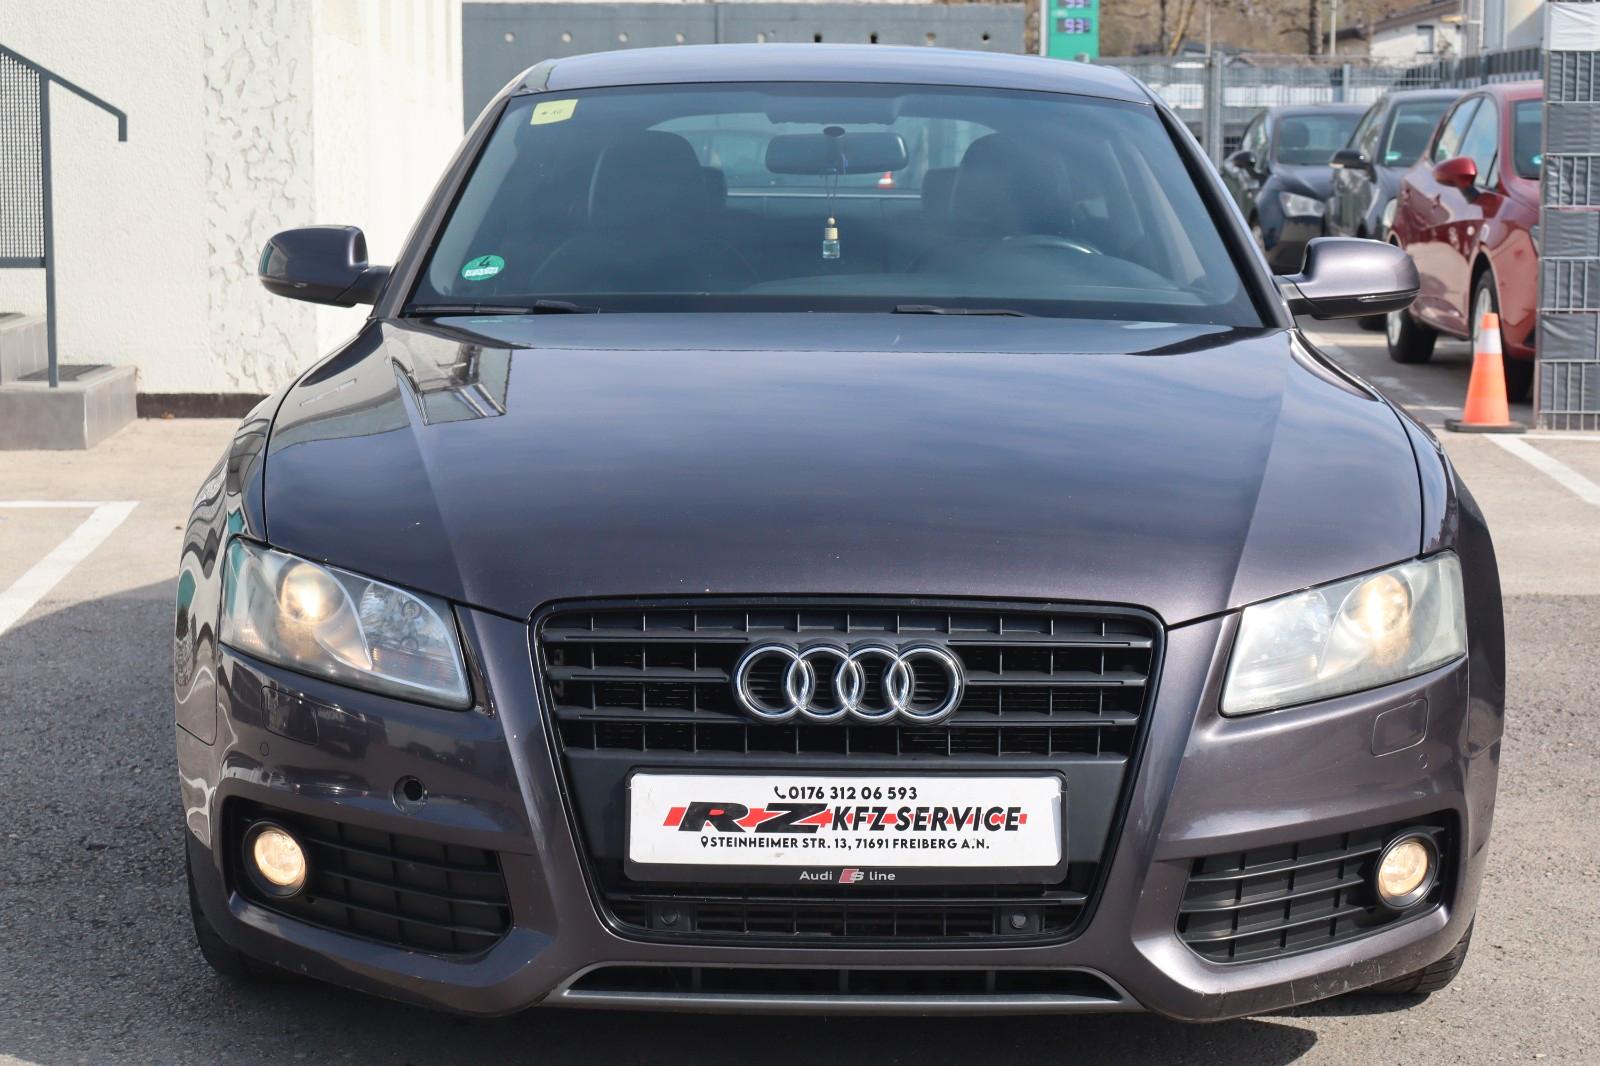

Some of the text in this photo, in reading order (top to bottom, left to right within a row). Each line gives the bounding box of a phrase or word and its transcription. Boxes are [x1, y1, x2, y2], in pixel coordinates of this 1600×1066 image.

[479, 256, 491, 267] 4
[788, 786, 918, 800] 0176 312 06 593
[831, 806, 888, 832] KFZ
[894, 806, 1022, 832] SERVICE
[710, 836, 990, 851] STEINHEIMER STR. 13, 71691 FREIBERG A.N.
[800, 870, 833, 881] Audi
[869, 871, 896, 881] line
